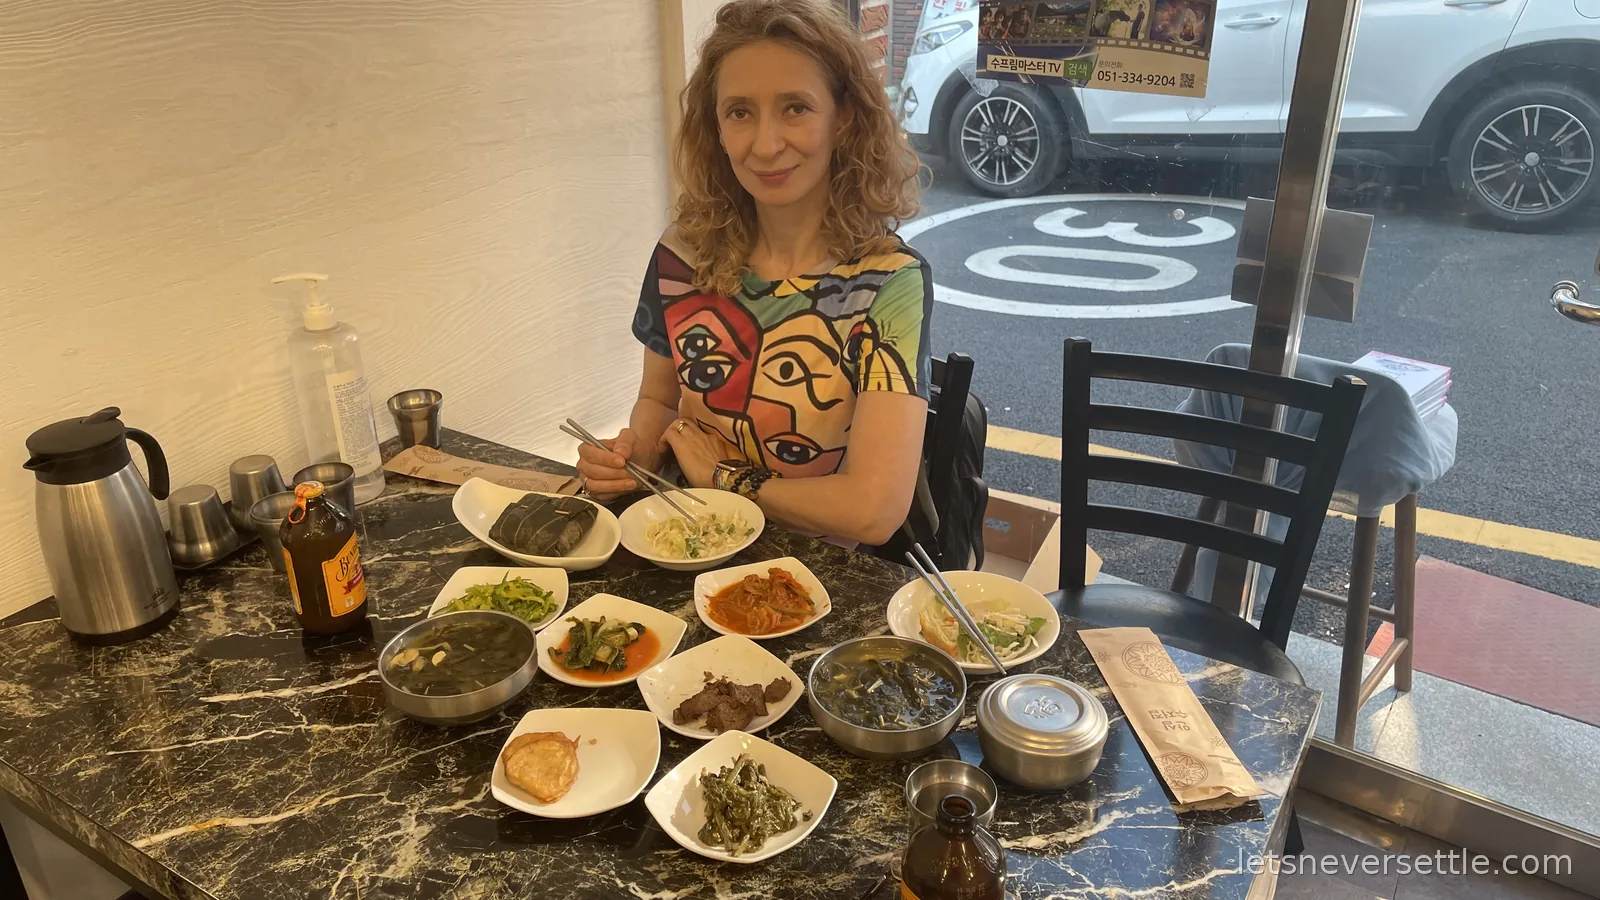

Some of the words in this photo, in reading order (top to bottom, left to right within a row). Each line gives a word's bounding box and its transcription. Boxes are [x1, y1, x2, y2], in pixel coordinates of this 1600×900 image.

[990, 57, 1046, 73] 수프림마스터
[1048, 62, 1062, 73] TV
[1068, 63, 1088, 77] 검색
[1097, 70, 1176, 87] 051-334-9204
[964, 207, 1237, 292] 30
